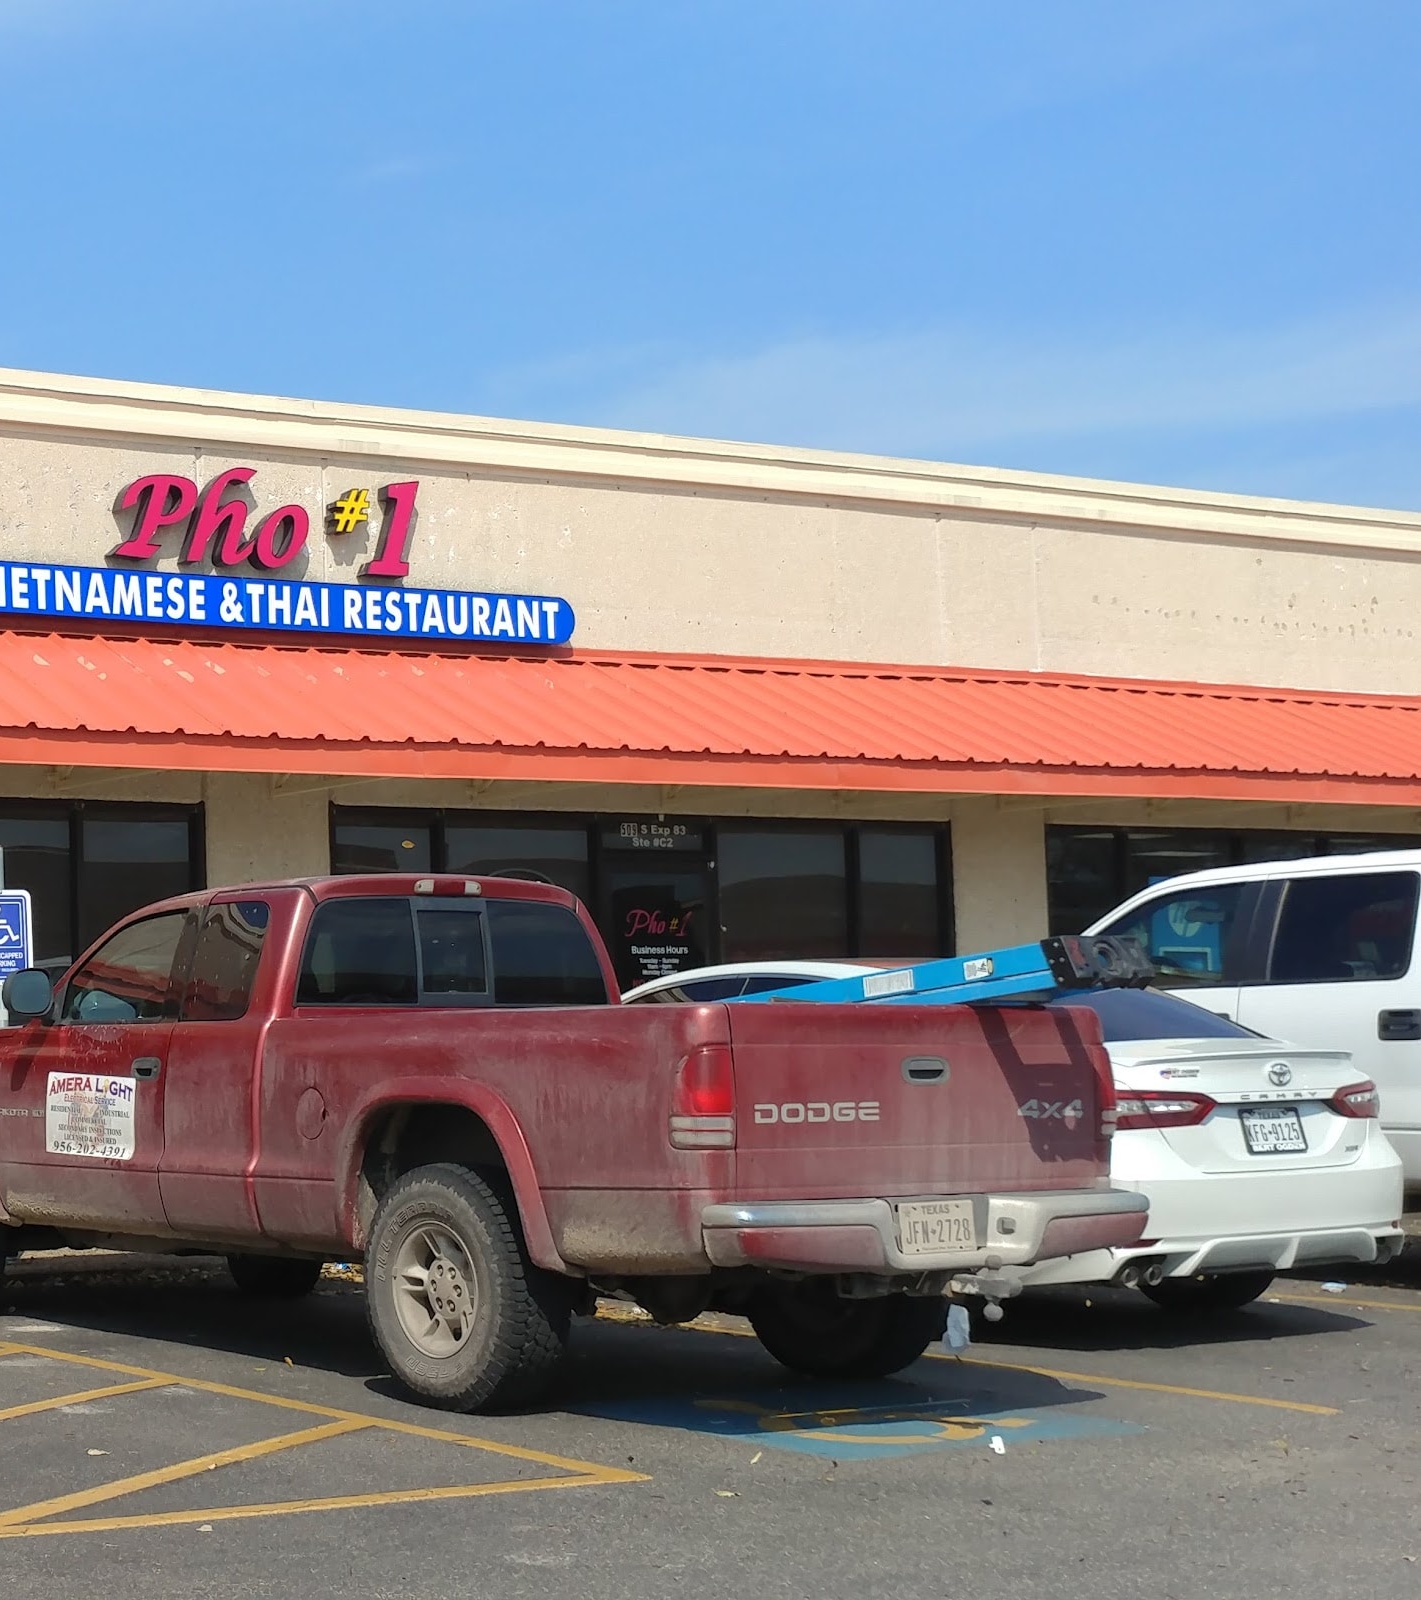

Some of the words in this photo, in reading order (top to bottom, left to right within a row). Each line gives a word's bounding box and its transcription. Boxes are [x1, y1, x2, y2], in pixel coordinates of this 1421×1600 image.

[112, 467, 310, 569] Pho
[343, 588, 560, 641] RESTAURANT
[640, 824, 648, 835] S
[650, 824, 671, 837] Exp
[672, 824, 686, 836] 83
[632, 837, 650, 847] Ste
[625, 909, 665, 937] Pho
[631, 945, 665, 954] Business
[666, 945, 688, 954] Hours
[49, 1077, 92, 1096] AMERA
[94, 1096, 116, 1106] SERVICE
[1240, 1092, 1317, 1100] CAMRY
[99, 1109, 130, 1118] INDUSTRIAL
[754, 1101, 880, 1124] DODGE
[53, 1140, 126, 1158] 956-202-4391
[921, 1204, 950, 1214] TEXAS
